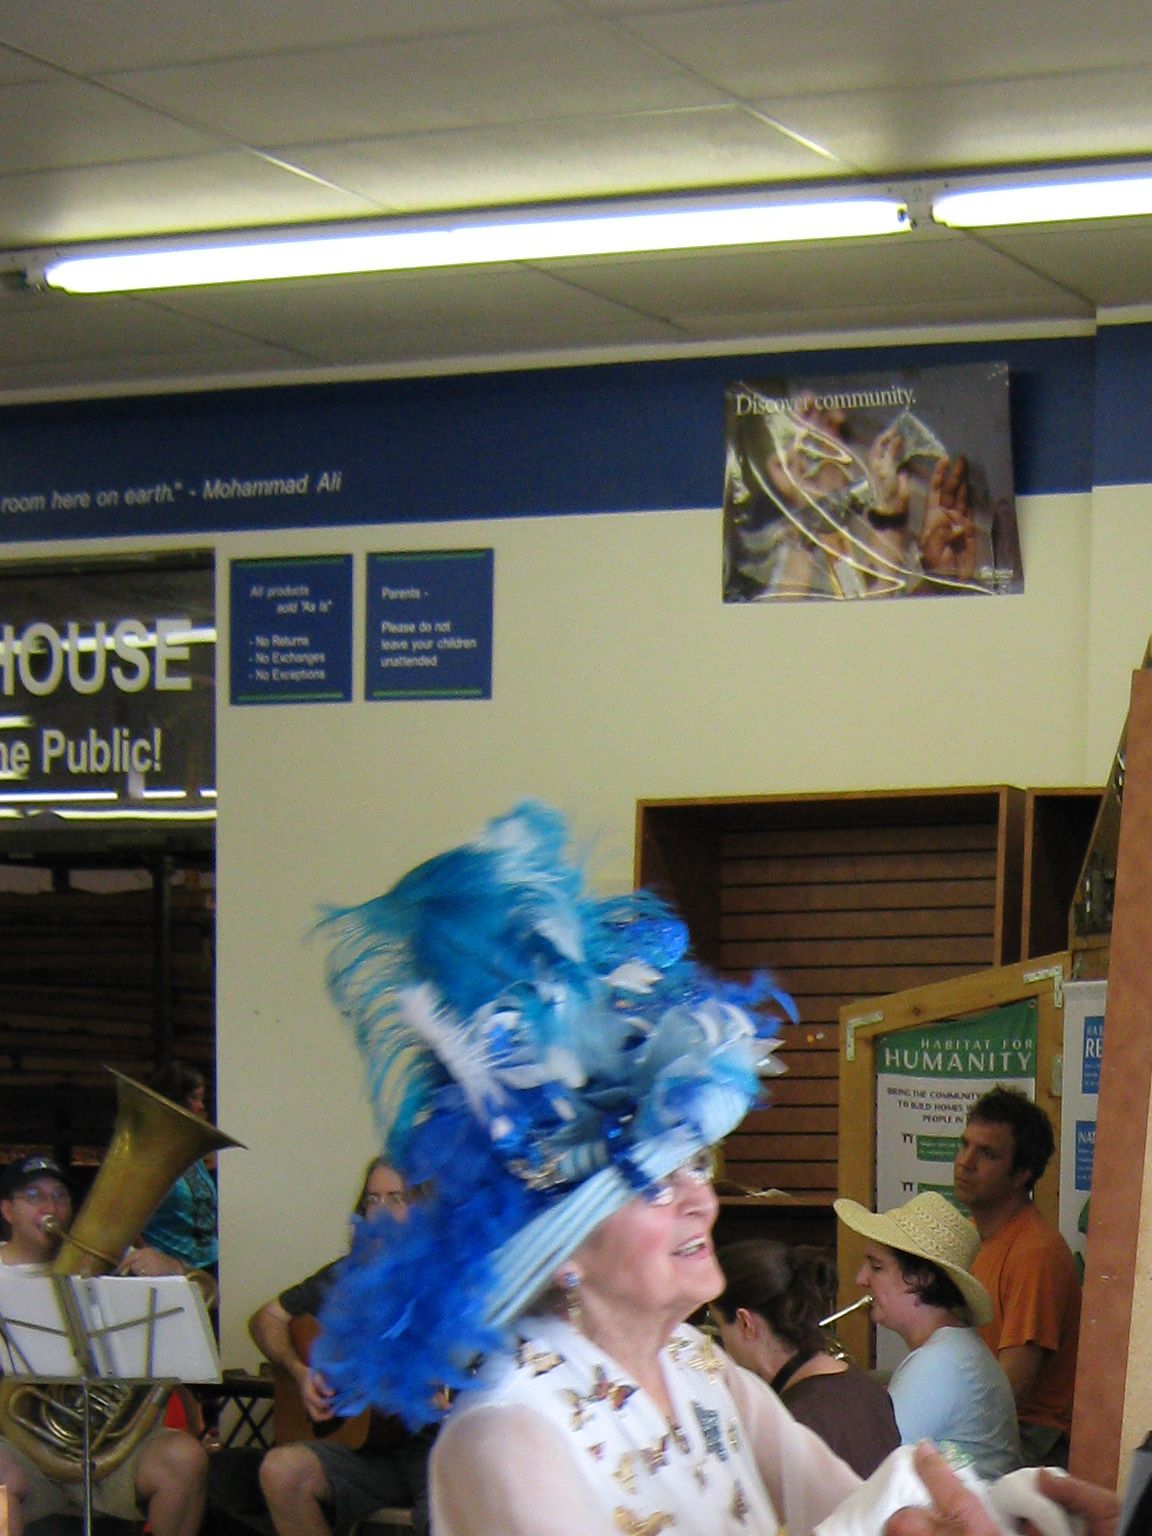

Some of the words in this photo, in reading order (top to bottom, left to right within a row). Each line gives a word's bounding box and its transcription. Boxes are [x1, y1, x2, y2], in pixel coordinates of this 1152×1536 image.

[735, 393, 808, 416] Discover
[815, 386, 917, 411] community.
[52, 490, 90, 510] here
[97, 489, 118, 506] on
[203, 474, 309, 499] Mohammad
[316, 472, 343, 493] Ali
[267, 585, 310, 601] products
[381, 587, 421, 600] Parents
[381, 621, 416, 634] Please
[418, 621, 433, 633] do
[434, 621, 452, 633] not
[255, 635, 270, 648] No
[271, 634, 310, 648] Returns
[381, 639, 408, 651] leave
[412, 640, 434, 654] your
[437, 637, 478, 650] children
[255, 652, 270, 664] No
[271, 651, 326, 666] Exchanges
[381, 655, 438, 668] unattended
[255, 669, 270, 681] No
[271, 668, 327, 682] Exceptions
[42, 727, 162, 773] Public!
[921, 1038, 991, 1050] HABITAT
[1002, 1039, 1034, 1049] FOR
[884, 1047, 1032, 1072] HUMANITY
[913, 1090, 926, 1099] THE
